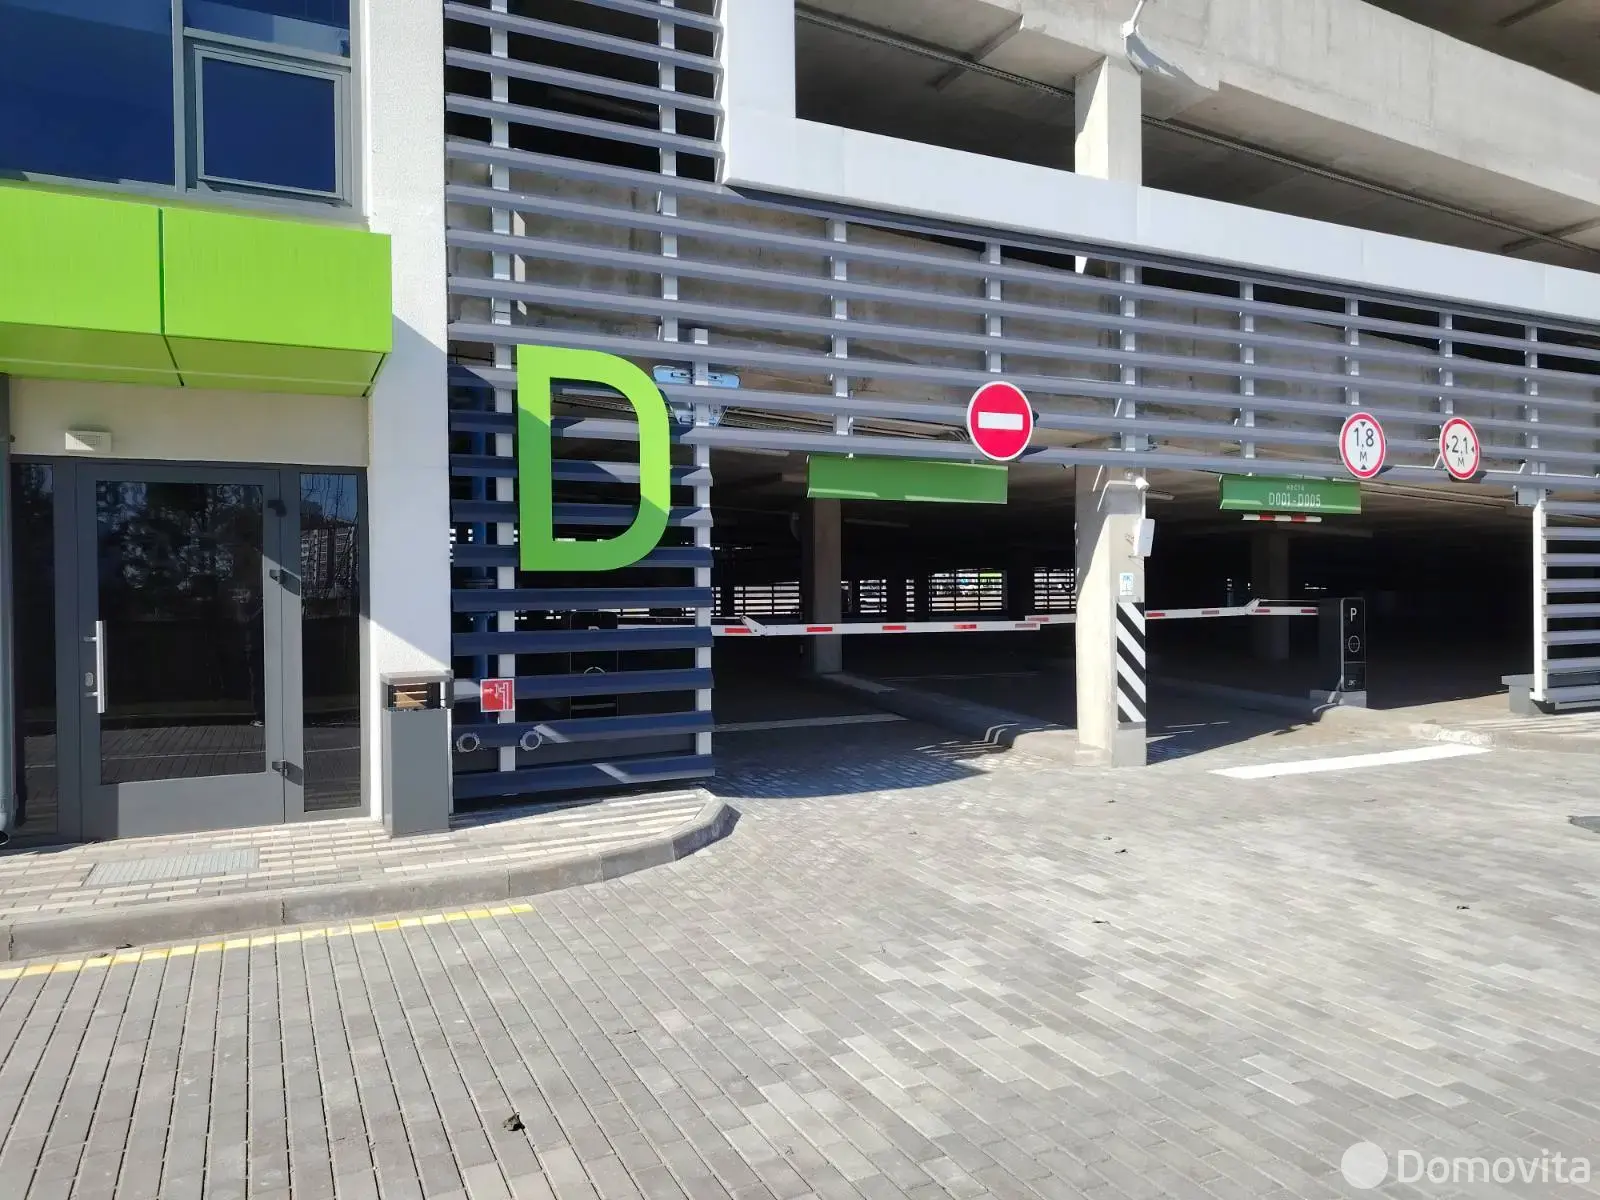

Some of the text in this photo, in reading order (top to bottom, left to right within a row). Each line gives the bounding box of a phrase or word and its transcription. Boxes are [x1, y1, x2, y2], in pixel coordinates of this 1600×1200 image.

[517, 343, 671, 571] D
[1269, 492, 1321, 507] D001-D005
[1350, 607, 1357, 622] P
